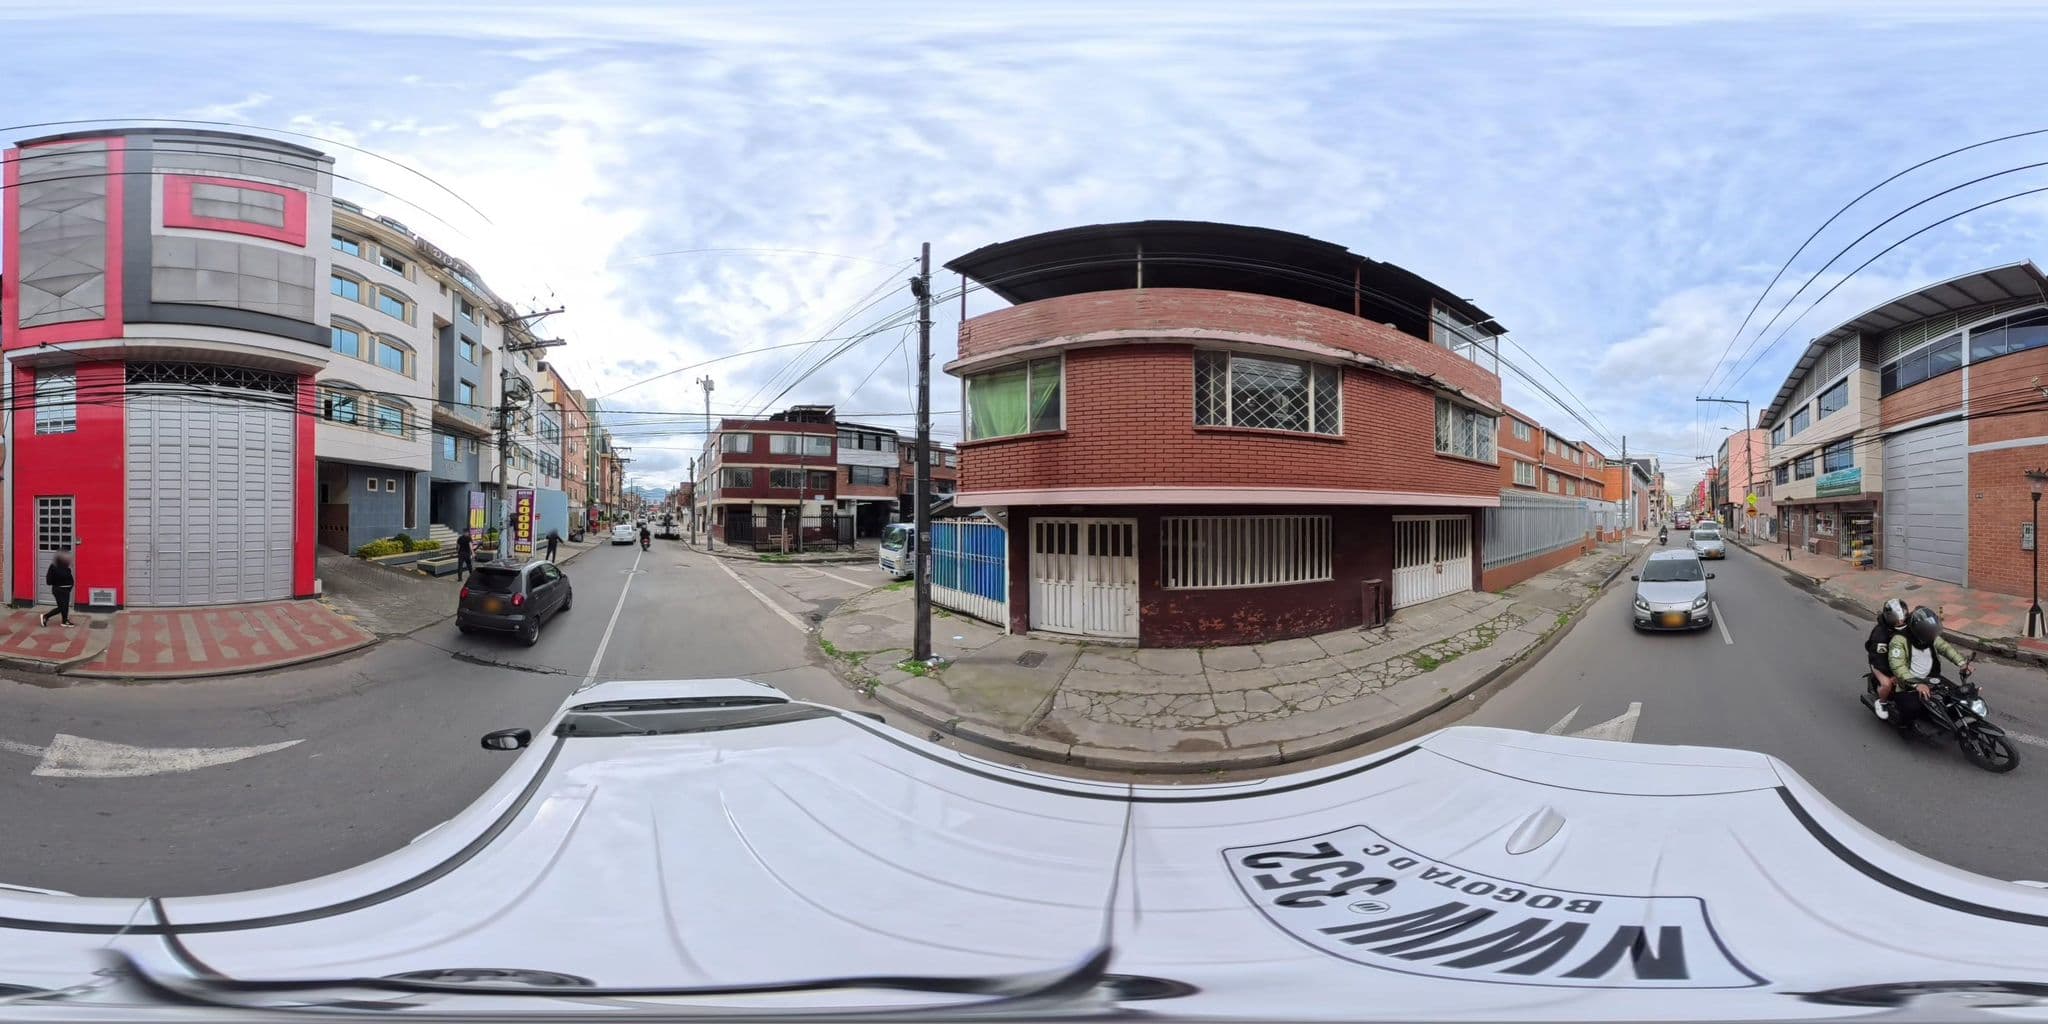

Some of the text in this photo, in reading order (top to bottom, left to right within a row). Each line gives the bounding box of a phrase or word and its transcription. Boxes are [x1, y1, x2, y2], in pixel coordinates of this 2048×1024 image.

[1242, 842, 1690, 980] NWW 352
[1362, 844, 1603, 914] BOGOTA D C
